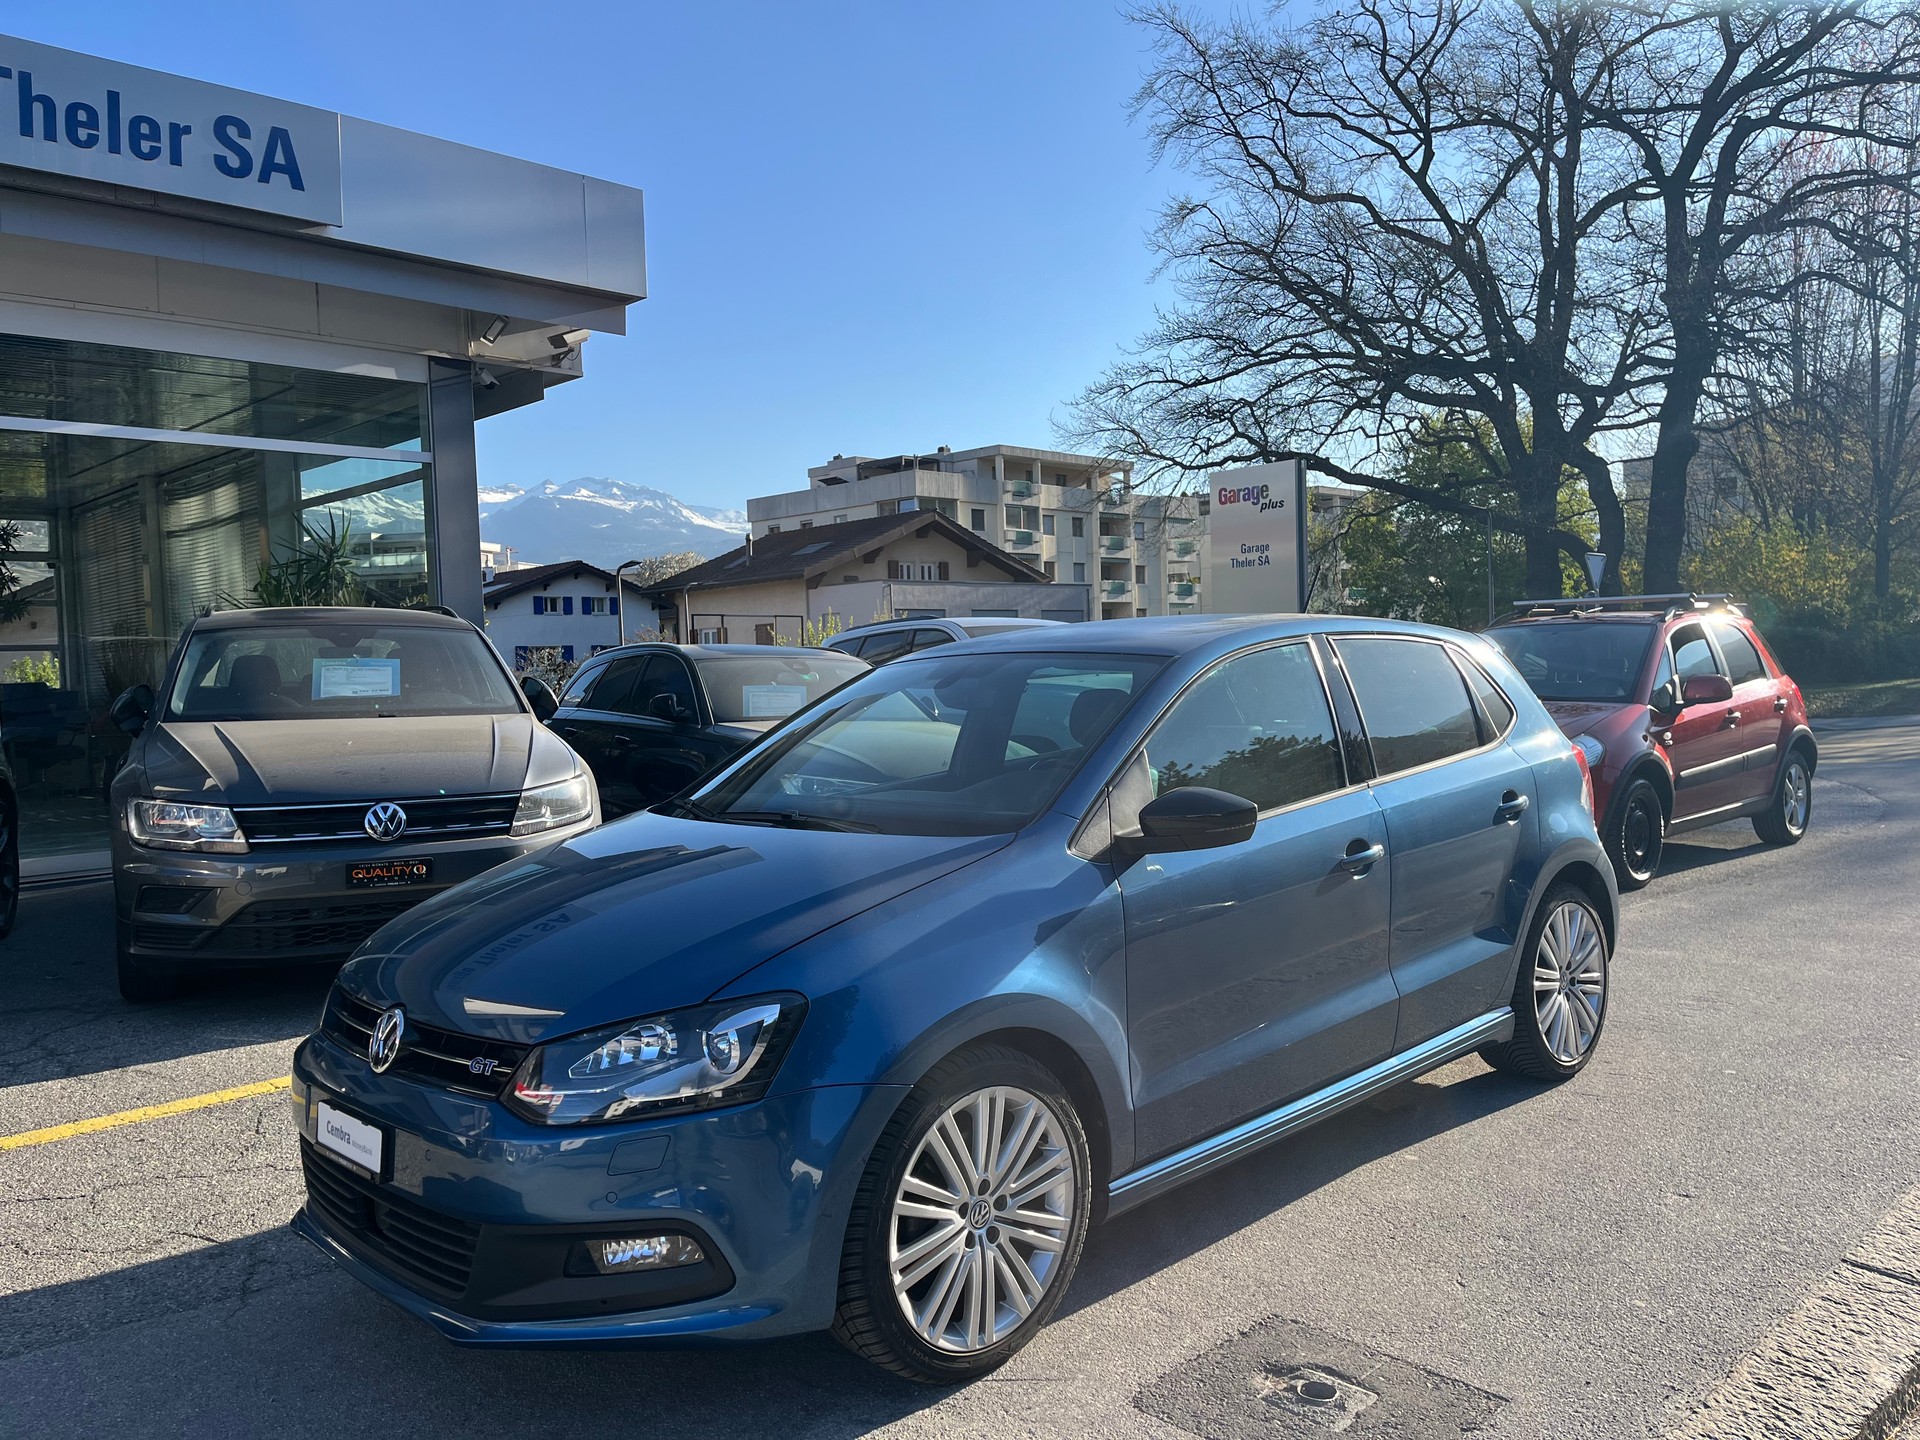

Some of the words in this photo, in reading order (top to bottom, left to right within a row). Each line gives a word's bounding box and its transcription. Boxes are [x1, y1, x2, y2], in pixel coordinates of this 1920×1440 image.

[212, 114, 305, 192] SA
[1218, 484, 1270, 506] Garage
[1259, 498, 1285, 513] plus
[1240, 543, 1270, 555] Garage
[1230, 557, 1256, 569] Theler
[1257, 555, 1271, 566] SA
[365, 802, 407, 841] VW
[352, 865, 413, 879] QUALITY
[369, 1008, 405, 1074] VW
[469, 1056, 499, 1076] GT
[326, 1120, 351, 1145] Cembra
[970, 1200, 991, 1229] VW
